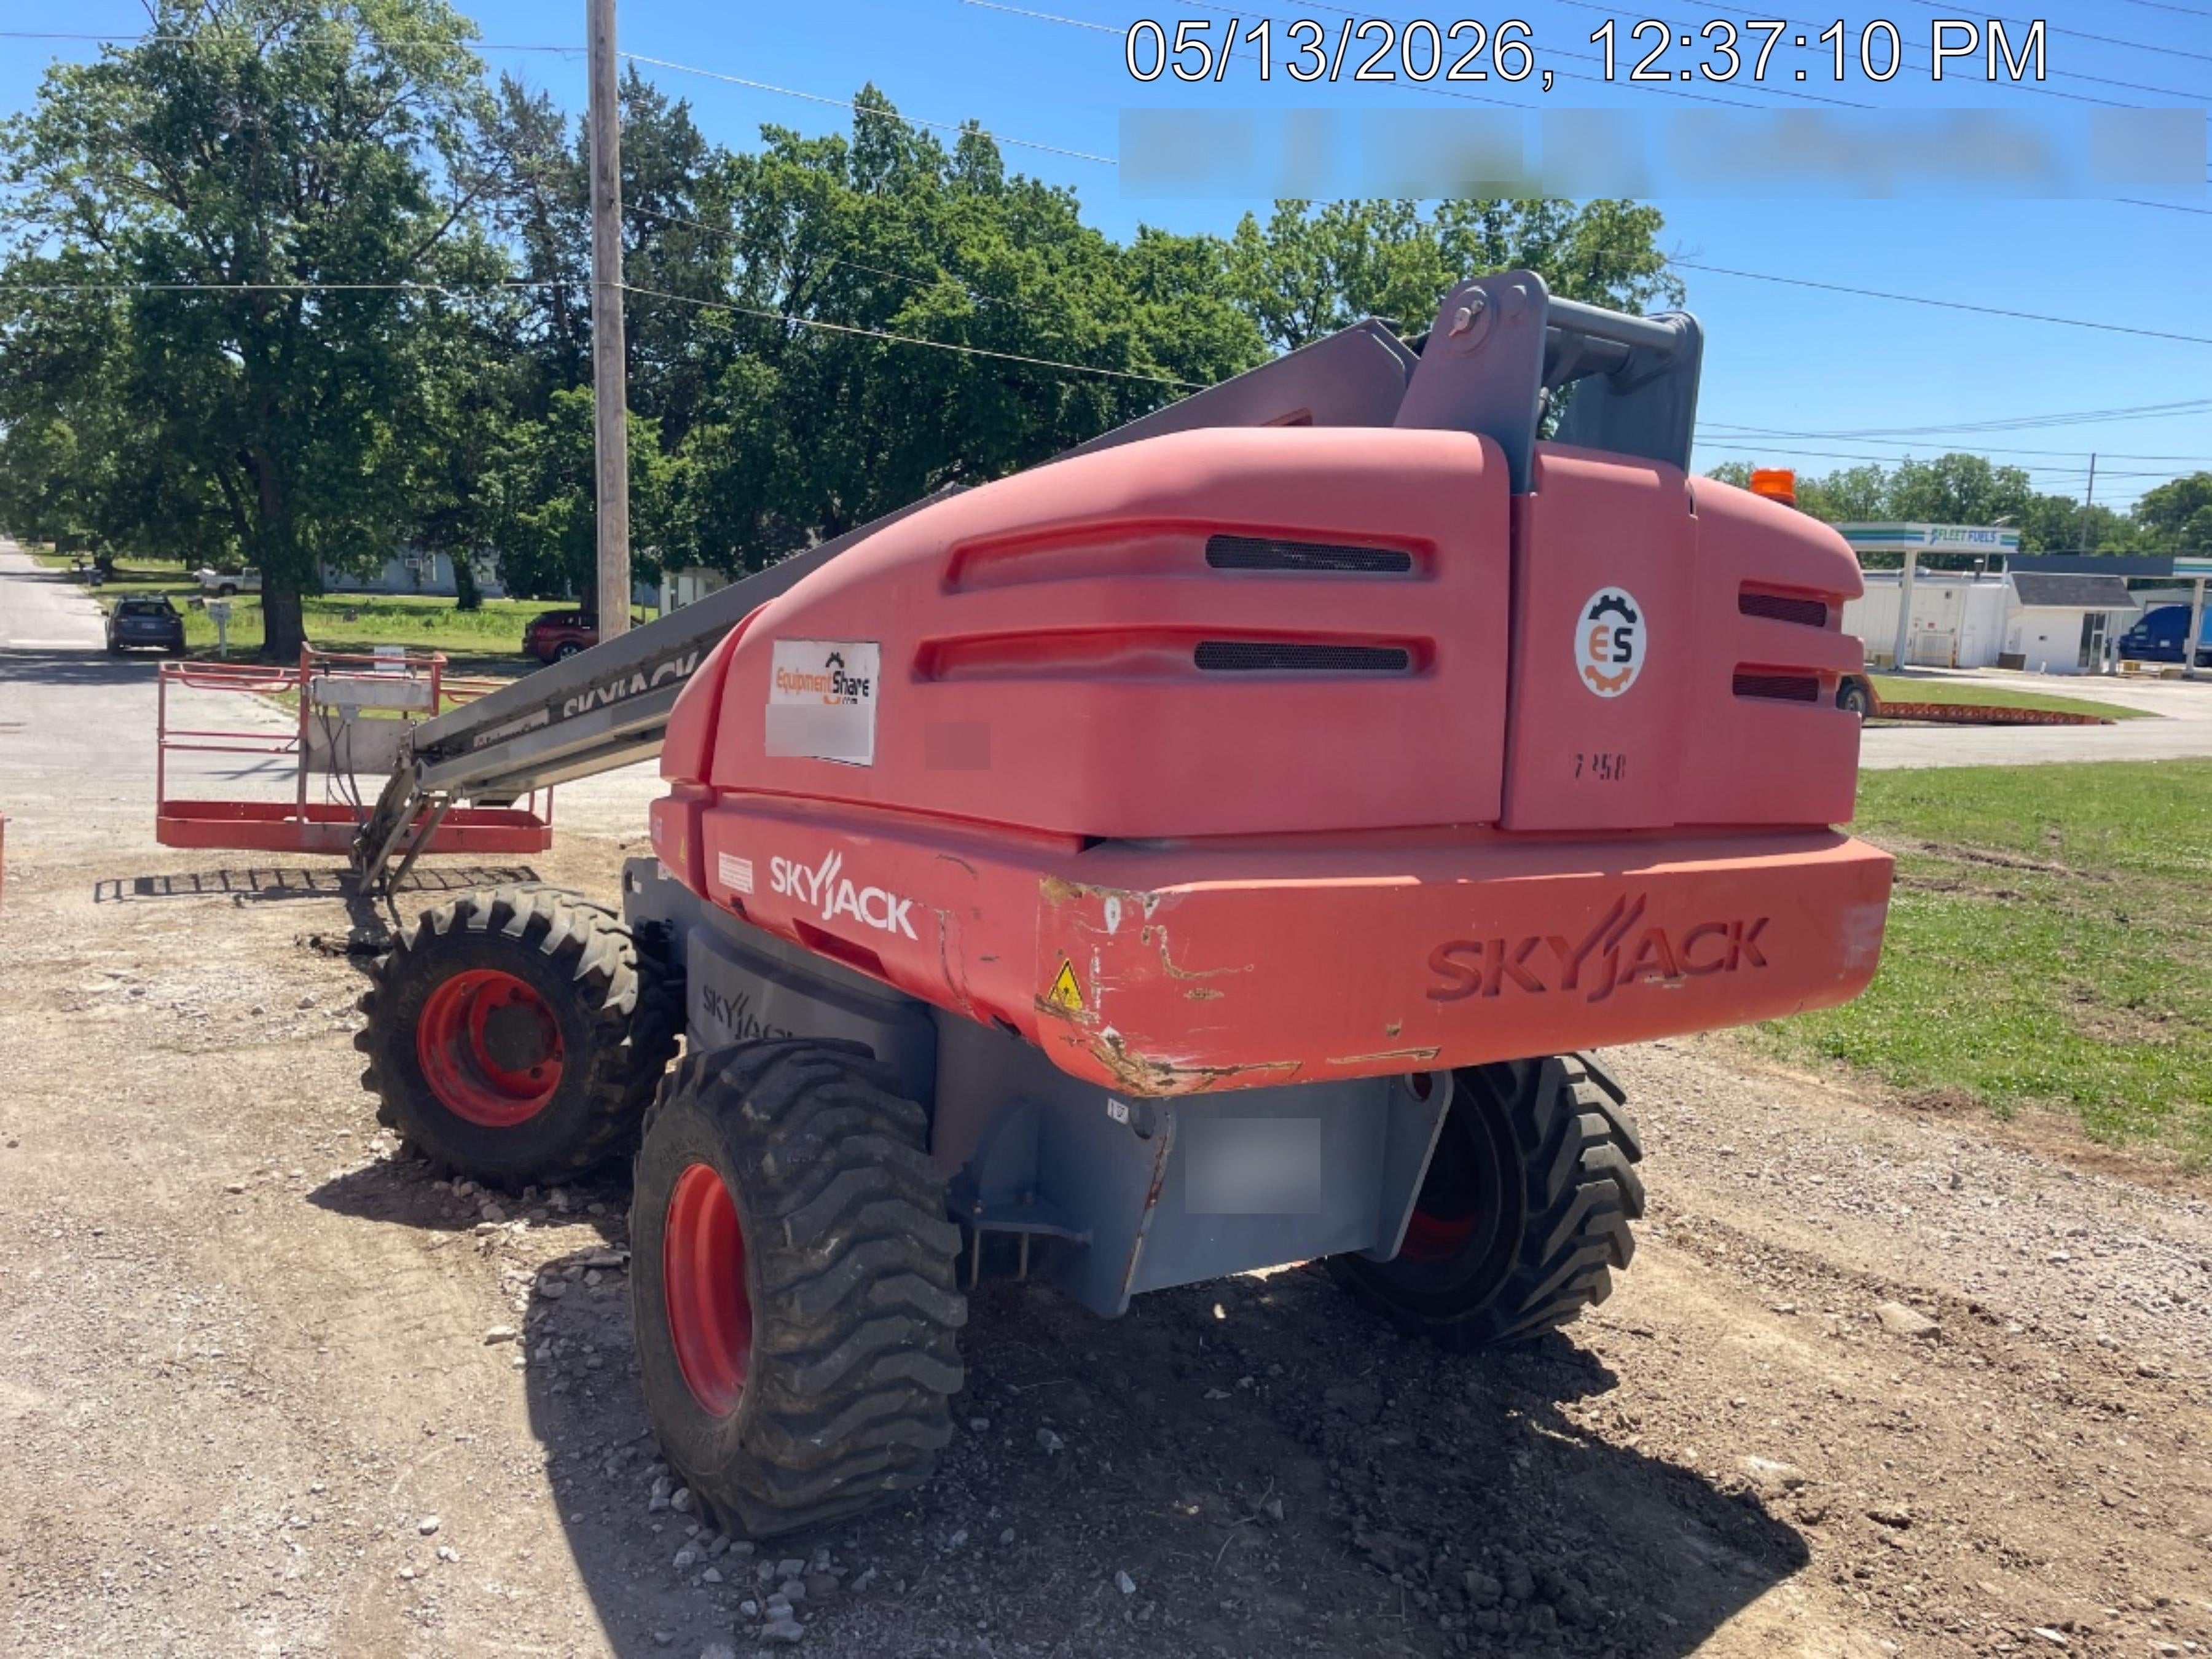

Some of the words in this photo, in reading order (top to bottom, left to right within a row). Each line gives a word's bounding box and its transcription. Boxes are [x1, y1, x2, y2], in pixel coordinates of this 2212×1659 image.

[1939, 528, 1967, 541] FLEET
[1969, 530, 1996, 543] FUELS
[1588, 625, 1634, 663] ES
[777, 667, 870, 697] EquipmentShare
[770, 849, 919, 940] SKYJACK
[1426, 892, 1770, 1003] SKYJACK
[704, 986, 794, 1038] SKYJAC
